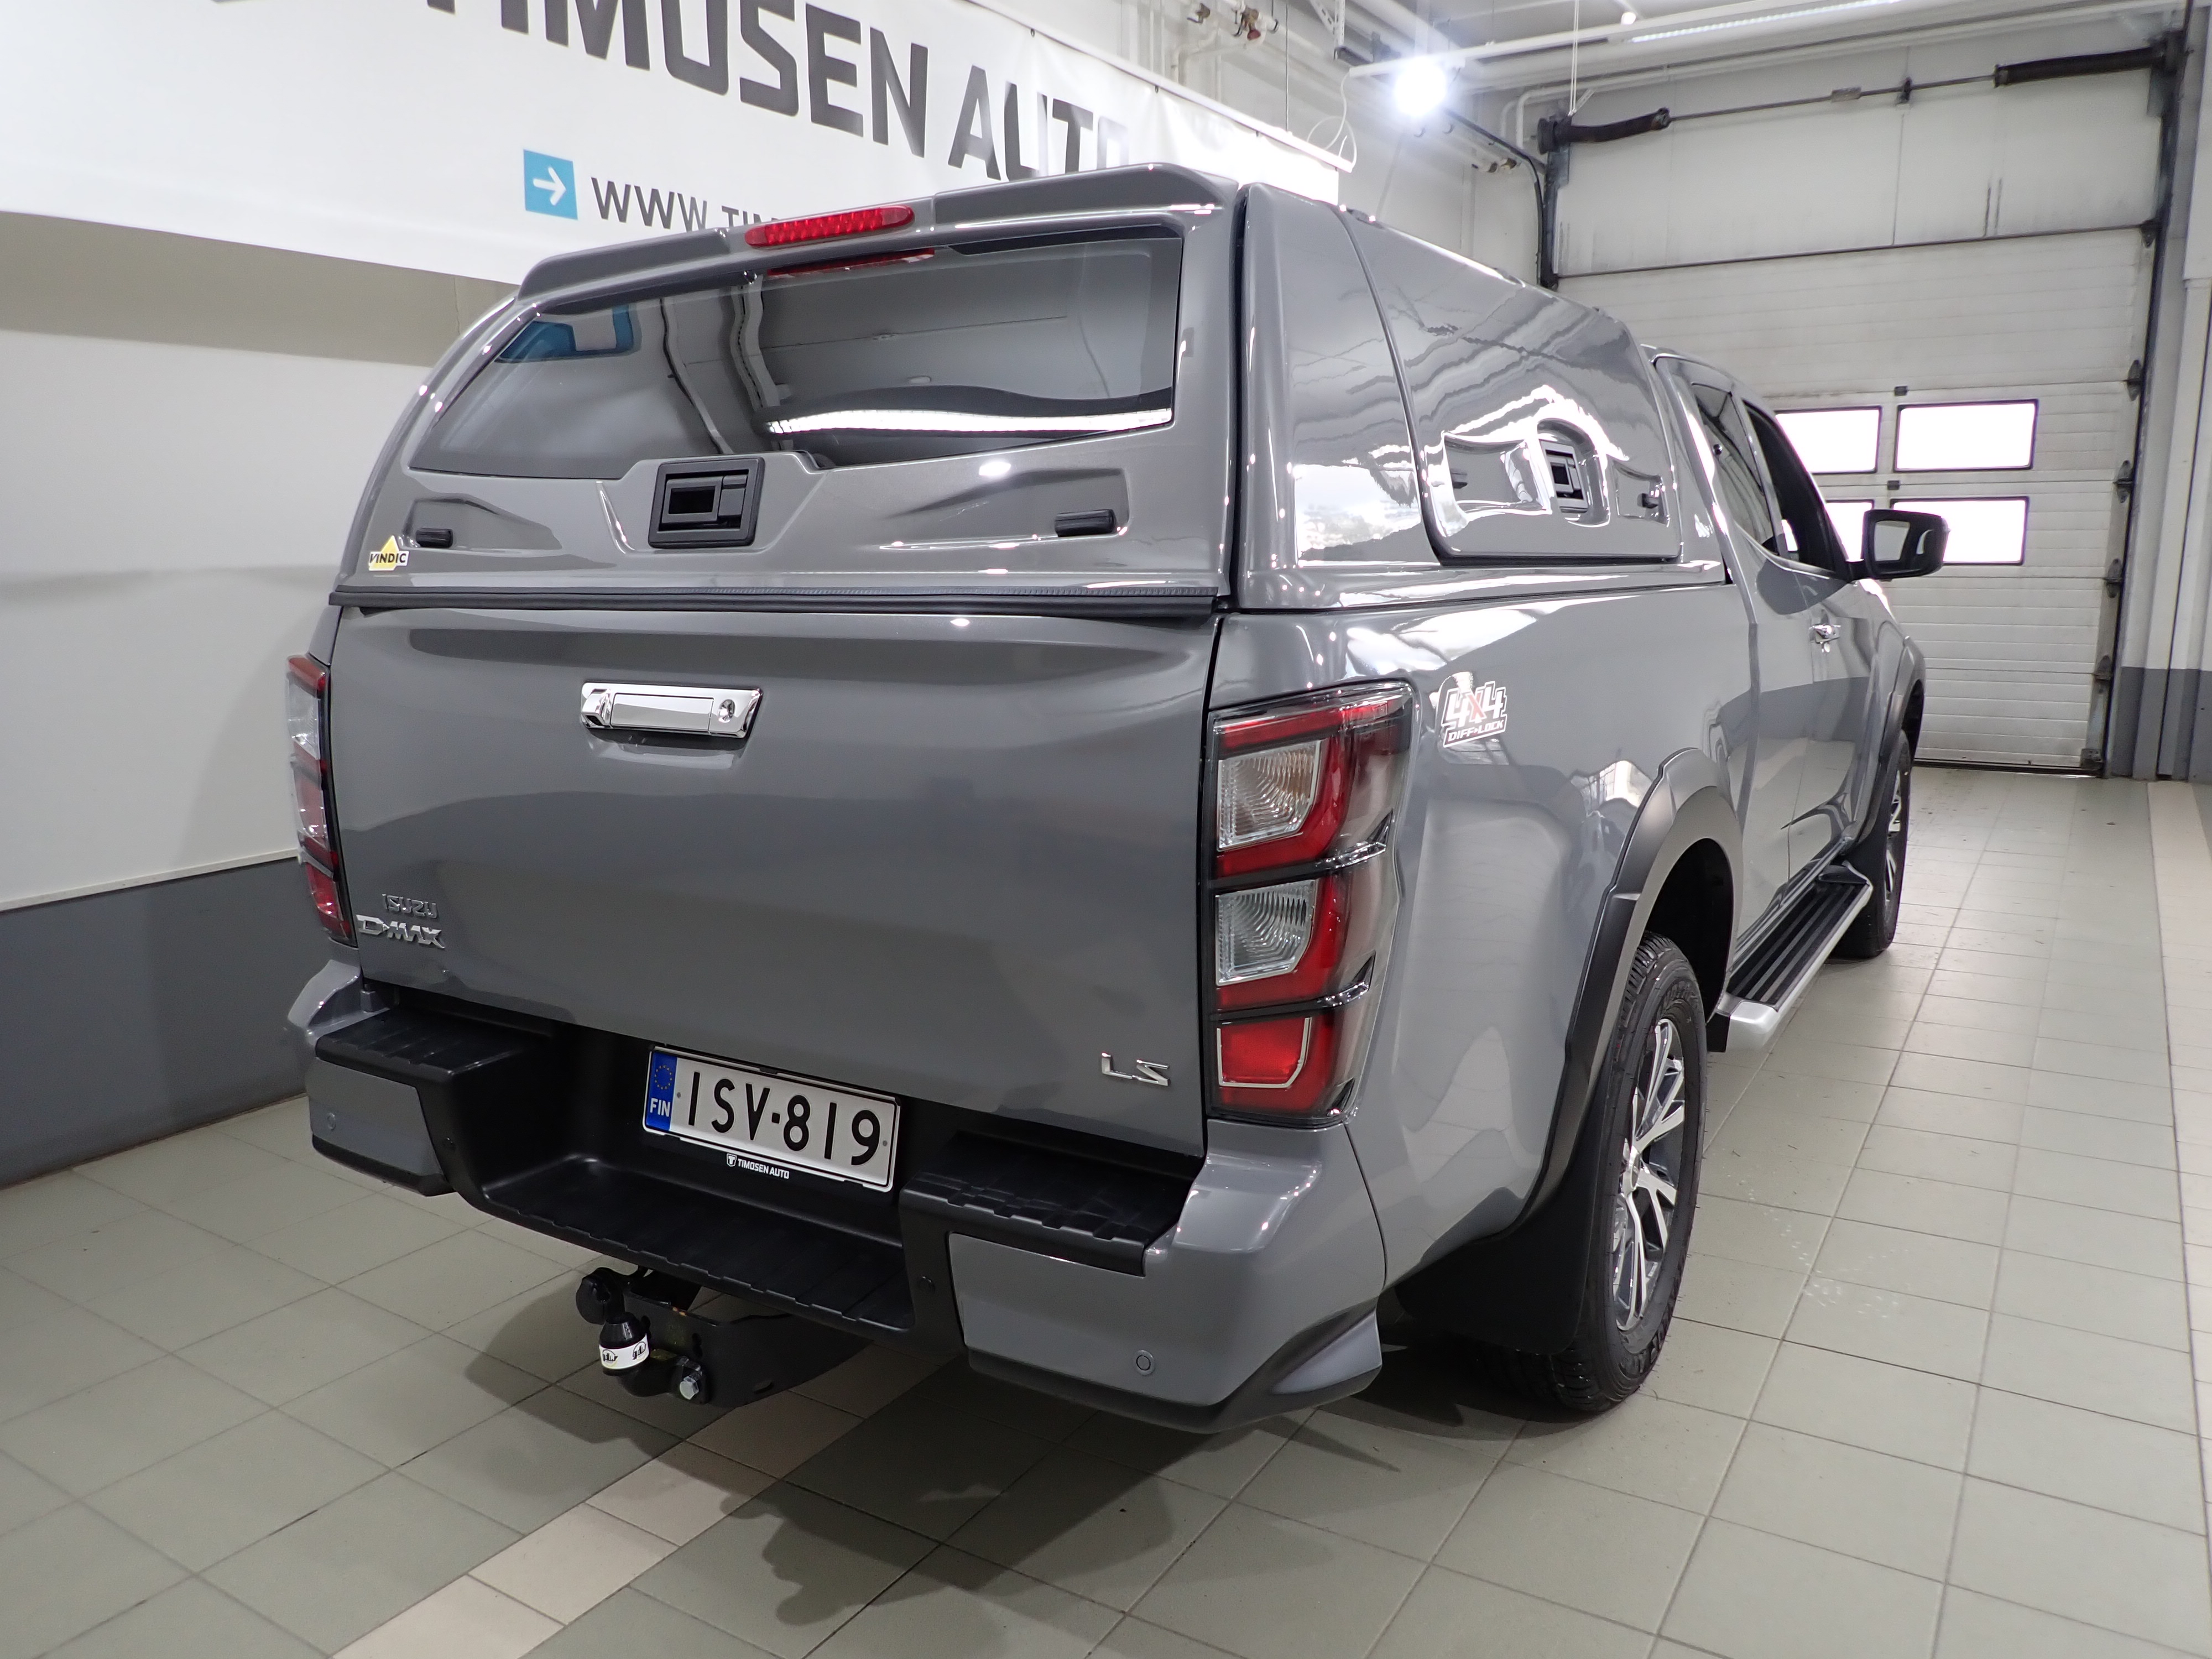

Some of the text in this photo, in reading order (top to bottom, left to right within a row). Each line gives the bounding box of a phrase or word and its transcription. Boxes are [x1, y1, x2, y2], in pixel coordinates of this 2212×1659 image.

[370, 553, 406, 564] VINDIC
[382, 894, 437, 919] ISUZU
[1102, 1052, 1169, 1086] LS
[649, 1098, 671, 1117] FIN
[688, 1071, 881, 1166] ISV-819
[737, 1158, 769, 1174] TIMOSEN
[769, 1167, 790, 1180] AUTO
